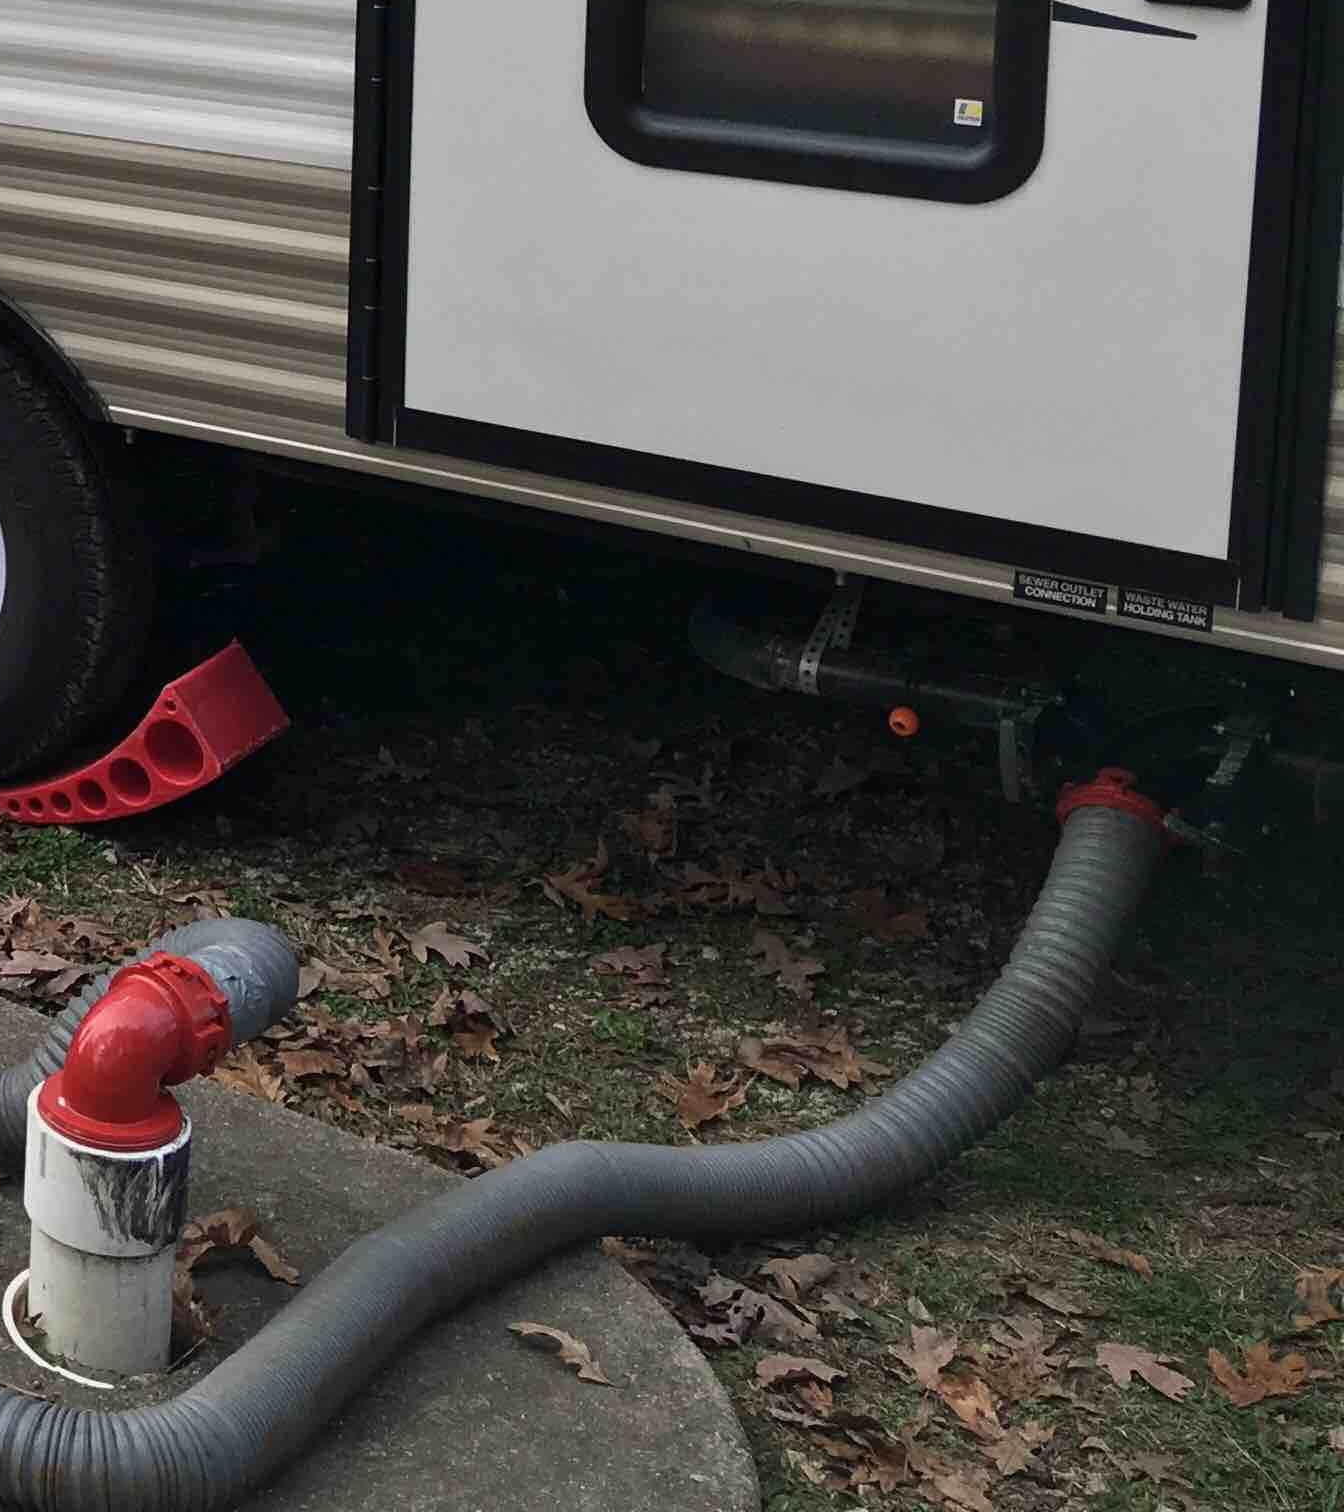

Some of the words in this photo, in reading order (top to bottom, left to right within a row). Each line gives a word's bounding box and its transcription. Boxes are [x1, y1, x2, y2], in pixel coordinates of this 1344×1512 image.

[1020, 574, 1059, 589] SEWER
[1060, 582, 1105, 598] OUTLET
[1024, 586, 1097, 607] CONNECTION
[1123, 602, 1174, 620] HOLDING
[1176, 612, 1207, 627] TANK
[1124, 591, 1165, 606] WASTE
[1166, 599, 1208, 615] WATER
